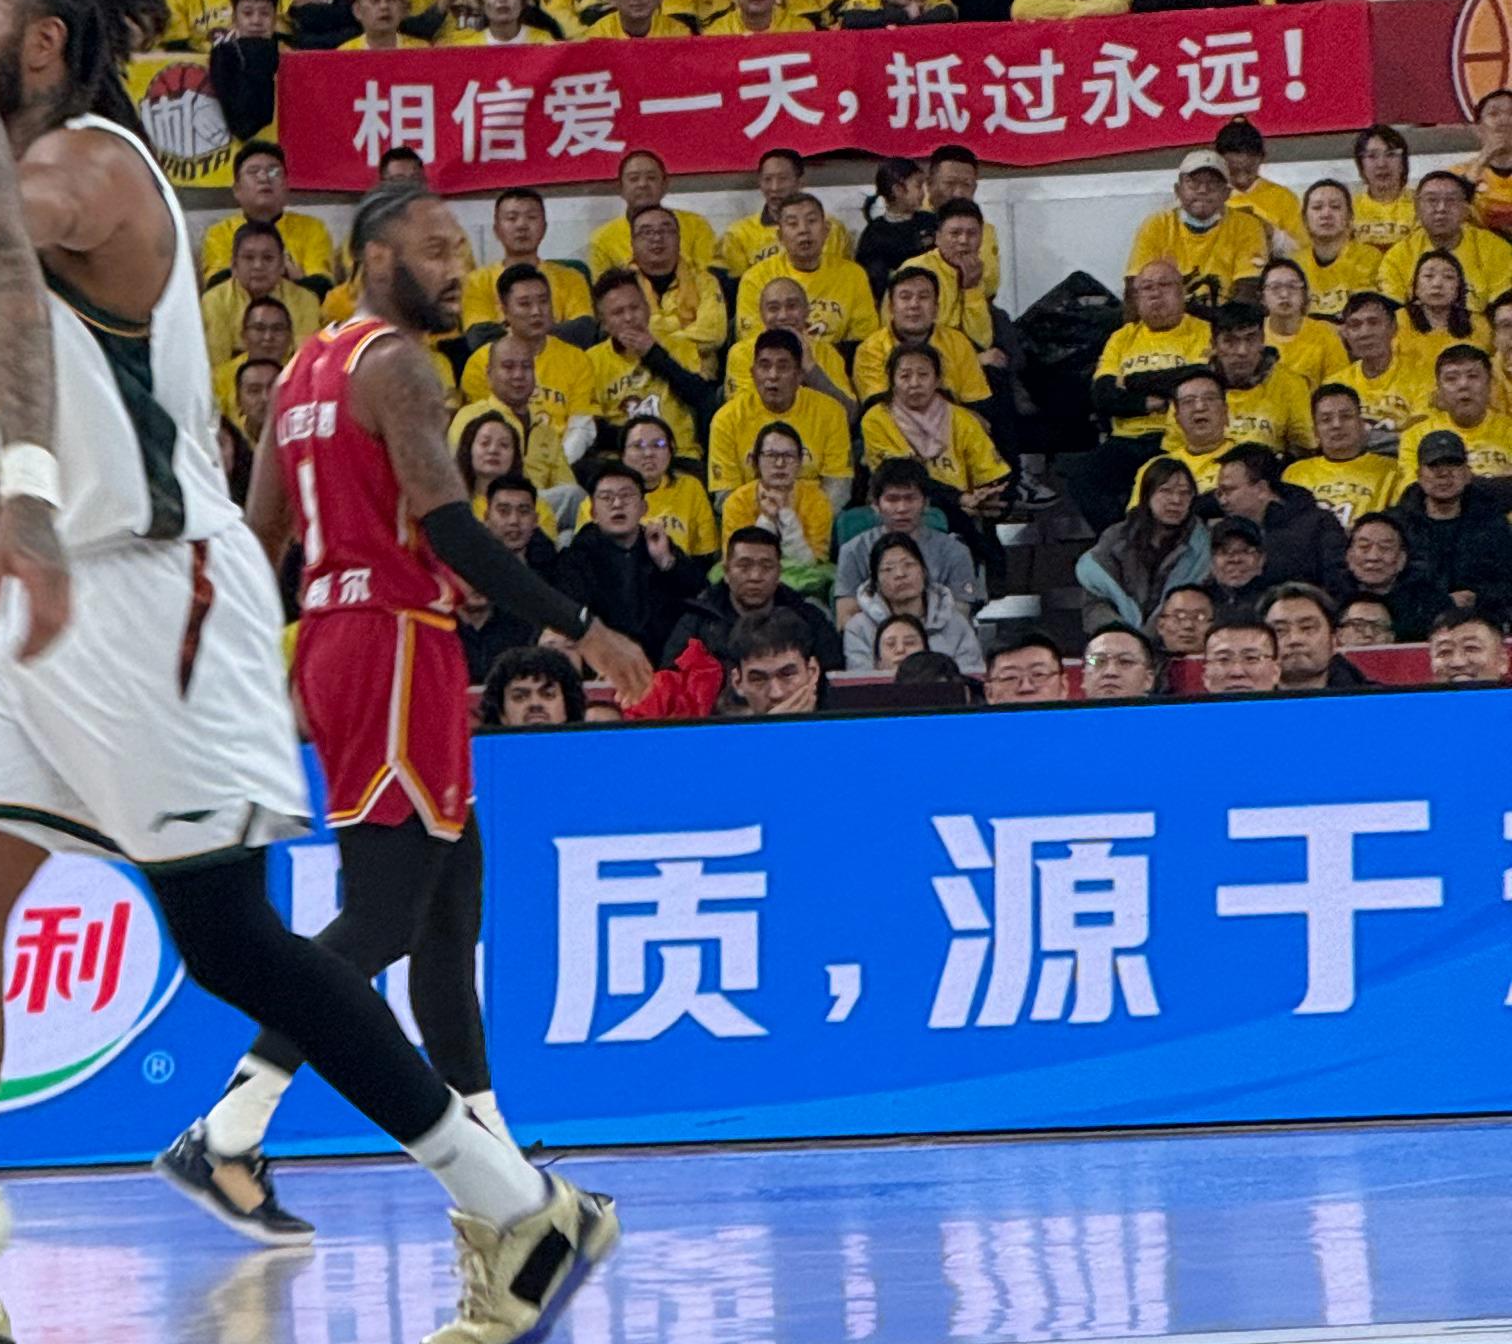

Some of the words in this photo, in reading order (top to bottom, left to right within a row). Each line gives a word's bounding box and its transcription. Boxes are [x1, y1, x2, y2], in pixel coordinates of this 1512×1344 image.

[352, 27, 1307, 168] 相信爱一天，抵过永远！
[291, 799, 1512, 1047] 质，源于
